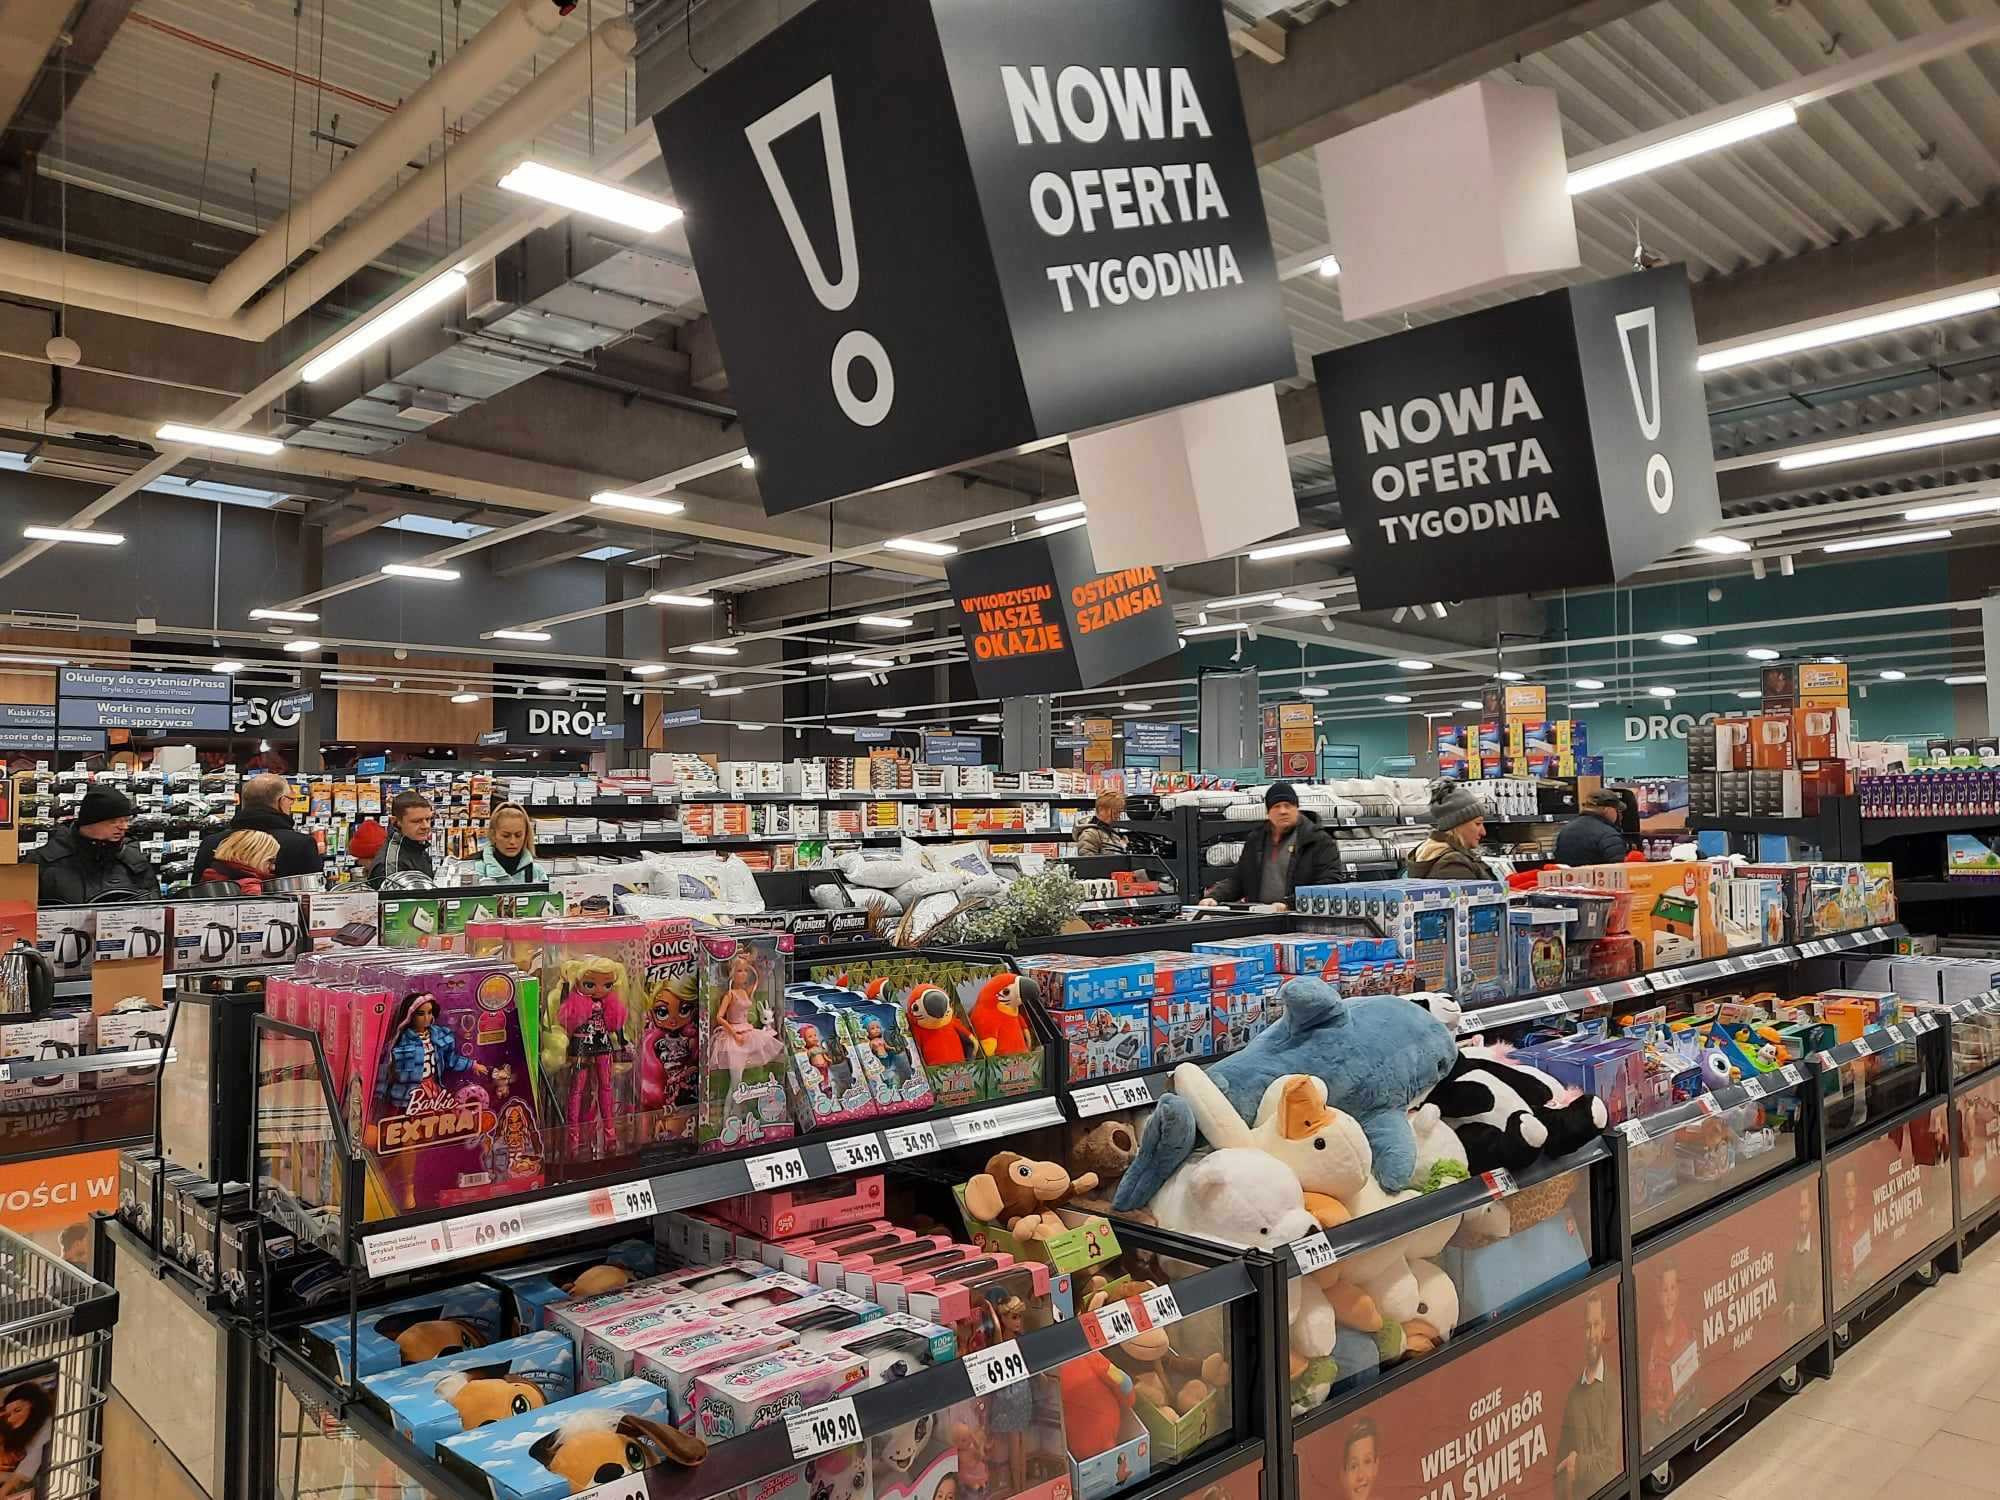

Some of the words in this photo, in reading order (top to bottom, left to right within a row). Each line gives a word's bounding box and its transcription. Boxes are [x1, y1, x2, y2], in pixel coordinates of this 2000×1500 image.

[1000, 64, 1213, 145] NOWA
[1029, 162, 1230, 237] OFERTA
[1046, 243, 1245, 313] TYGODNIA
[1359, 375, 1545, 455] NOWA
[1371, 437, 1553, 502] OFERTA
[1378, 491, 1561, 544] TYGODNIA
[961, 584, 1052, 613] WYKORZYSTAJ
[1071, 566, 1157, 608] OSTATNIA
[978, 604, 1043, 633] NASZE
[1076, 583, 1163, 635] SZANSA!
[974, 623, 1064, 659] OKAZJE
[65, 673, 115, 687] Okulary
[119, 676, 134, 685] do
[137, 677, 226, 689] czytania/Prasa
[96, 702, 133, 713] Worki
[136, 705, 151, 714] na
[154, 703, 196, 716] śmieci/
[99, 716, 128, 726] Folie
[131, 717, 194, 728] spożywcze
[794, 918, 827, 933] AVENGERS
[833, 915, 866, 931] AVENGERS
[652, 940, 690, 957] OMG
[646, 960, 697, 983] FIERCE
[406, 1088, 459, 1116] Barbie
[1124, 1086, 1149, 1102] 89.99
[385, 1109, 475, 1146] EXTRA
[847, 1144, 880, 1166] 34.99
[903, 1132, 935, 1153] 34.99
[766, 1160, 802, 1183] 79.99
[1872, 1184, 1896, 1206] WIELKI
[1896, 1163, 1920, 1192] WYBÓR
[87, 1176, 114, 1198] W
[626, 1191, 653, 1214] 99.99
[1873, 1208, 1889, 1237] NA
[1889, 1186, 1923, 1227] ŚWIĘTA
[1730, 1246, 1750, 1269] GDZIE
[1703, 1273, 1739, 1310] WIELKI
[1740, 1251, 1774, 1288] WYBÓR
[1155, 1296, 1178, 1319] 44.99
[1703, 1310, 1725, 1349] NA
[1727, 1278, 1778, 1333] ŚWIĘTA
[1111, 1311, 1134, 1336] 44.99
[932, 1334, 952, 1348] 100+
[987, 1353, 1023, 1384] 69.99
[1468, 1386, 1503, 1422] GDZIE
[812, 1413, 857, 1446] 149.90
[1421, 1425, 1482, 1483] WIELKI
[1485, 1389, 1543, 1446] WYBÓR
[1463, 1423, 1548, 1500] ŚWIĘTA
